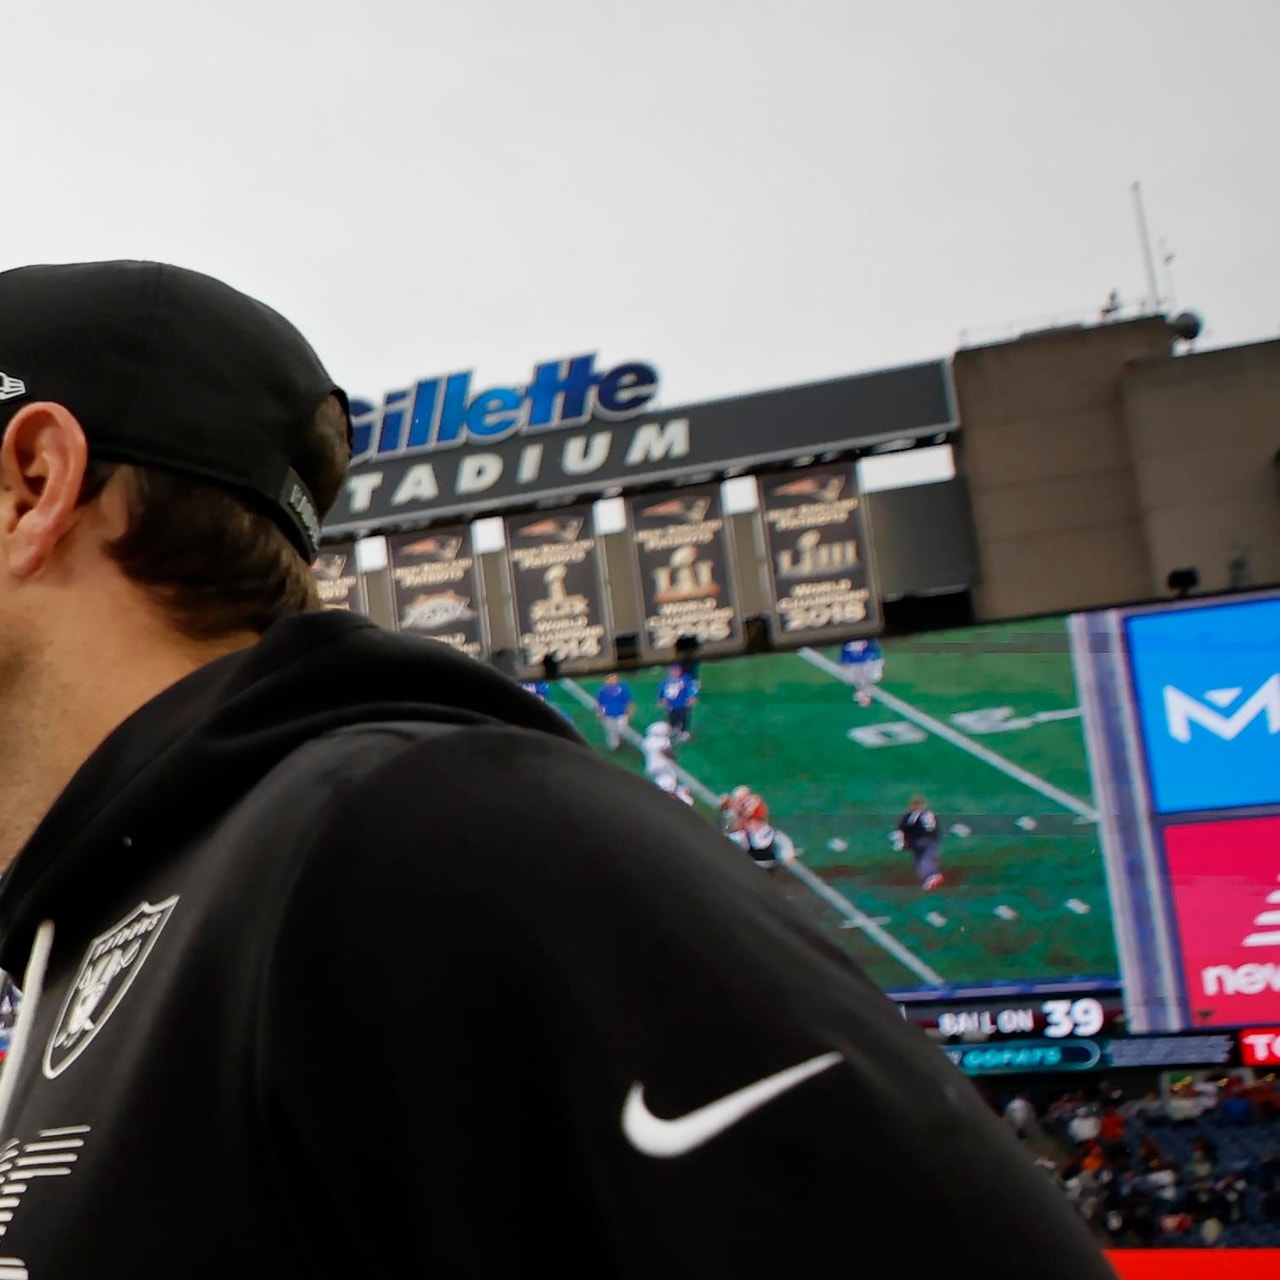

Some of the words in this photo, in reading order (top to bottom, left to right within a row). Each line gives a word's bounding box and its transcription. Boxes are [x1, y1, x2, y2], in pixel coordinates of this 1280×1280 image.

[345, 417, 690, 514] TADIUM
[938, 1010, 997, 1037] BALL
[997, 1008, 1035, 1034] ON
[1041, 997, 1104, 1039] 39
